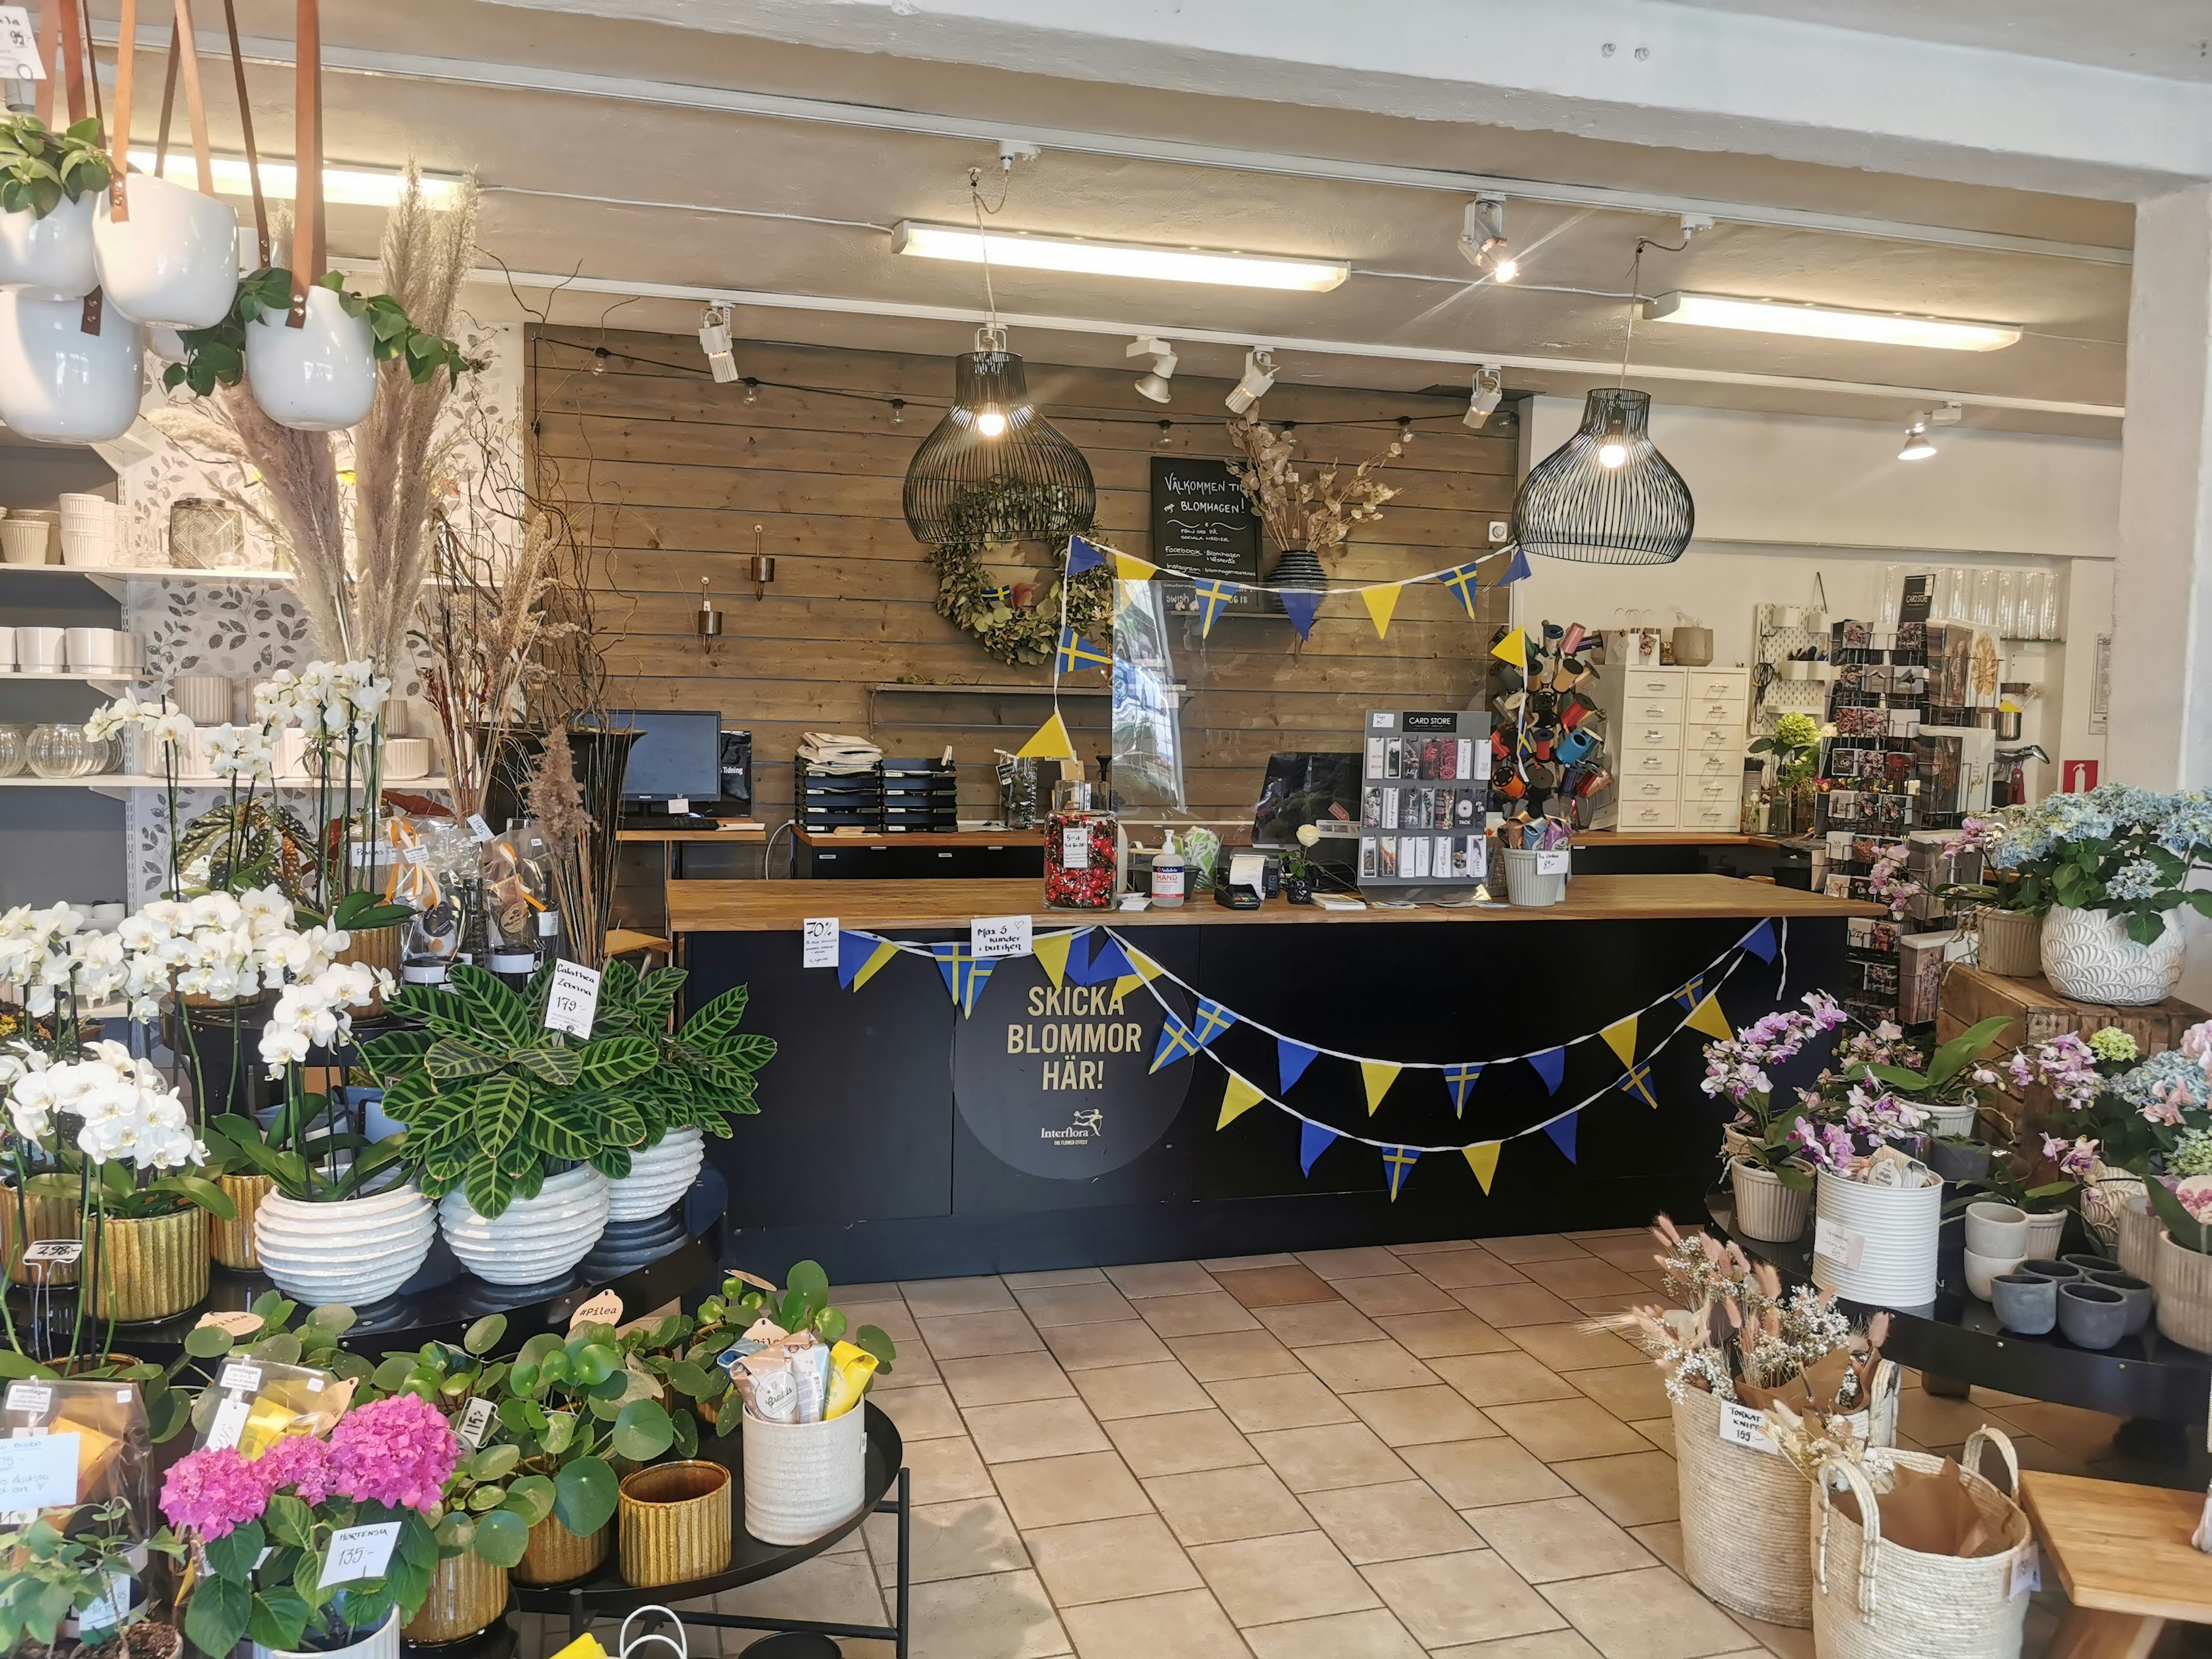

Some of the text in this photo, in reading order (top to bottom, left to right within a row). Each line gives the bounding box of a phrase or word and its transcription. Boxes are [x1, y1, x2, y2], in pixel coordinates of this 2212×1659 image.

[1164, 472, 1225, 495] VÄLKOMMEN
[1180, 497, 1245, 514] BLOMHAGEN!
[806, 922, 832, 937] 70%
[978, 925, 1007, 938] Max 5
[985, 944, 1021, 952] butiken
[557, 964, 594, 984] Calathea
[557, 978, 592, 997] Zebrina
[1027, 986, 1125, 1017] SKICKA
[1007, 1022, 1142, 1054] BLOMMOR
[1042, 1055, 1104, 1090] HÄR!
[1041, 1126, 1089, 1138] Interflora
[579, 1307, 617, 1316] #Pilea
[230, 1365, 258, 1375] blomhagen
[1728, 1407, 1763, 1422] TORKAT
[339, 1528, 388, 1541] HORTENSIA
